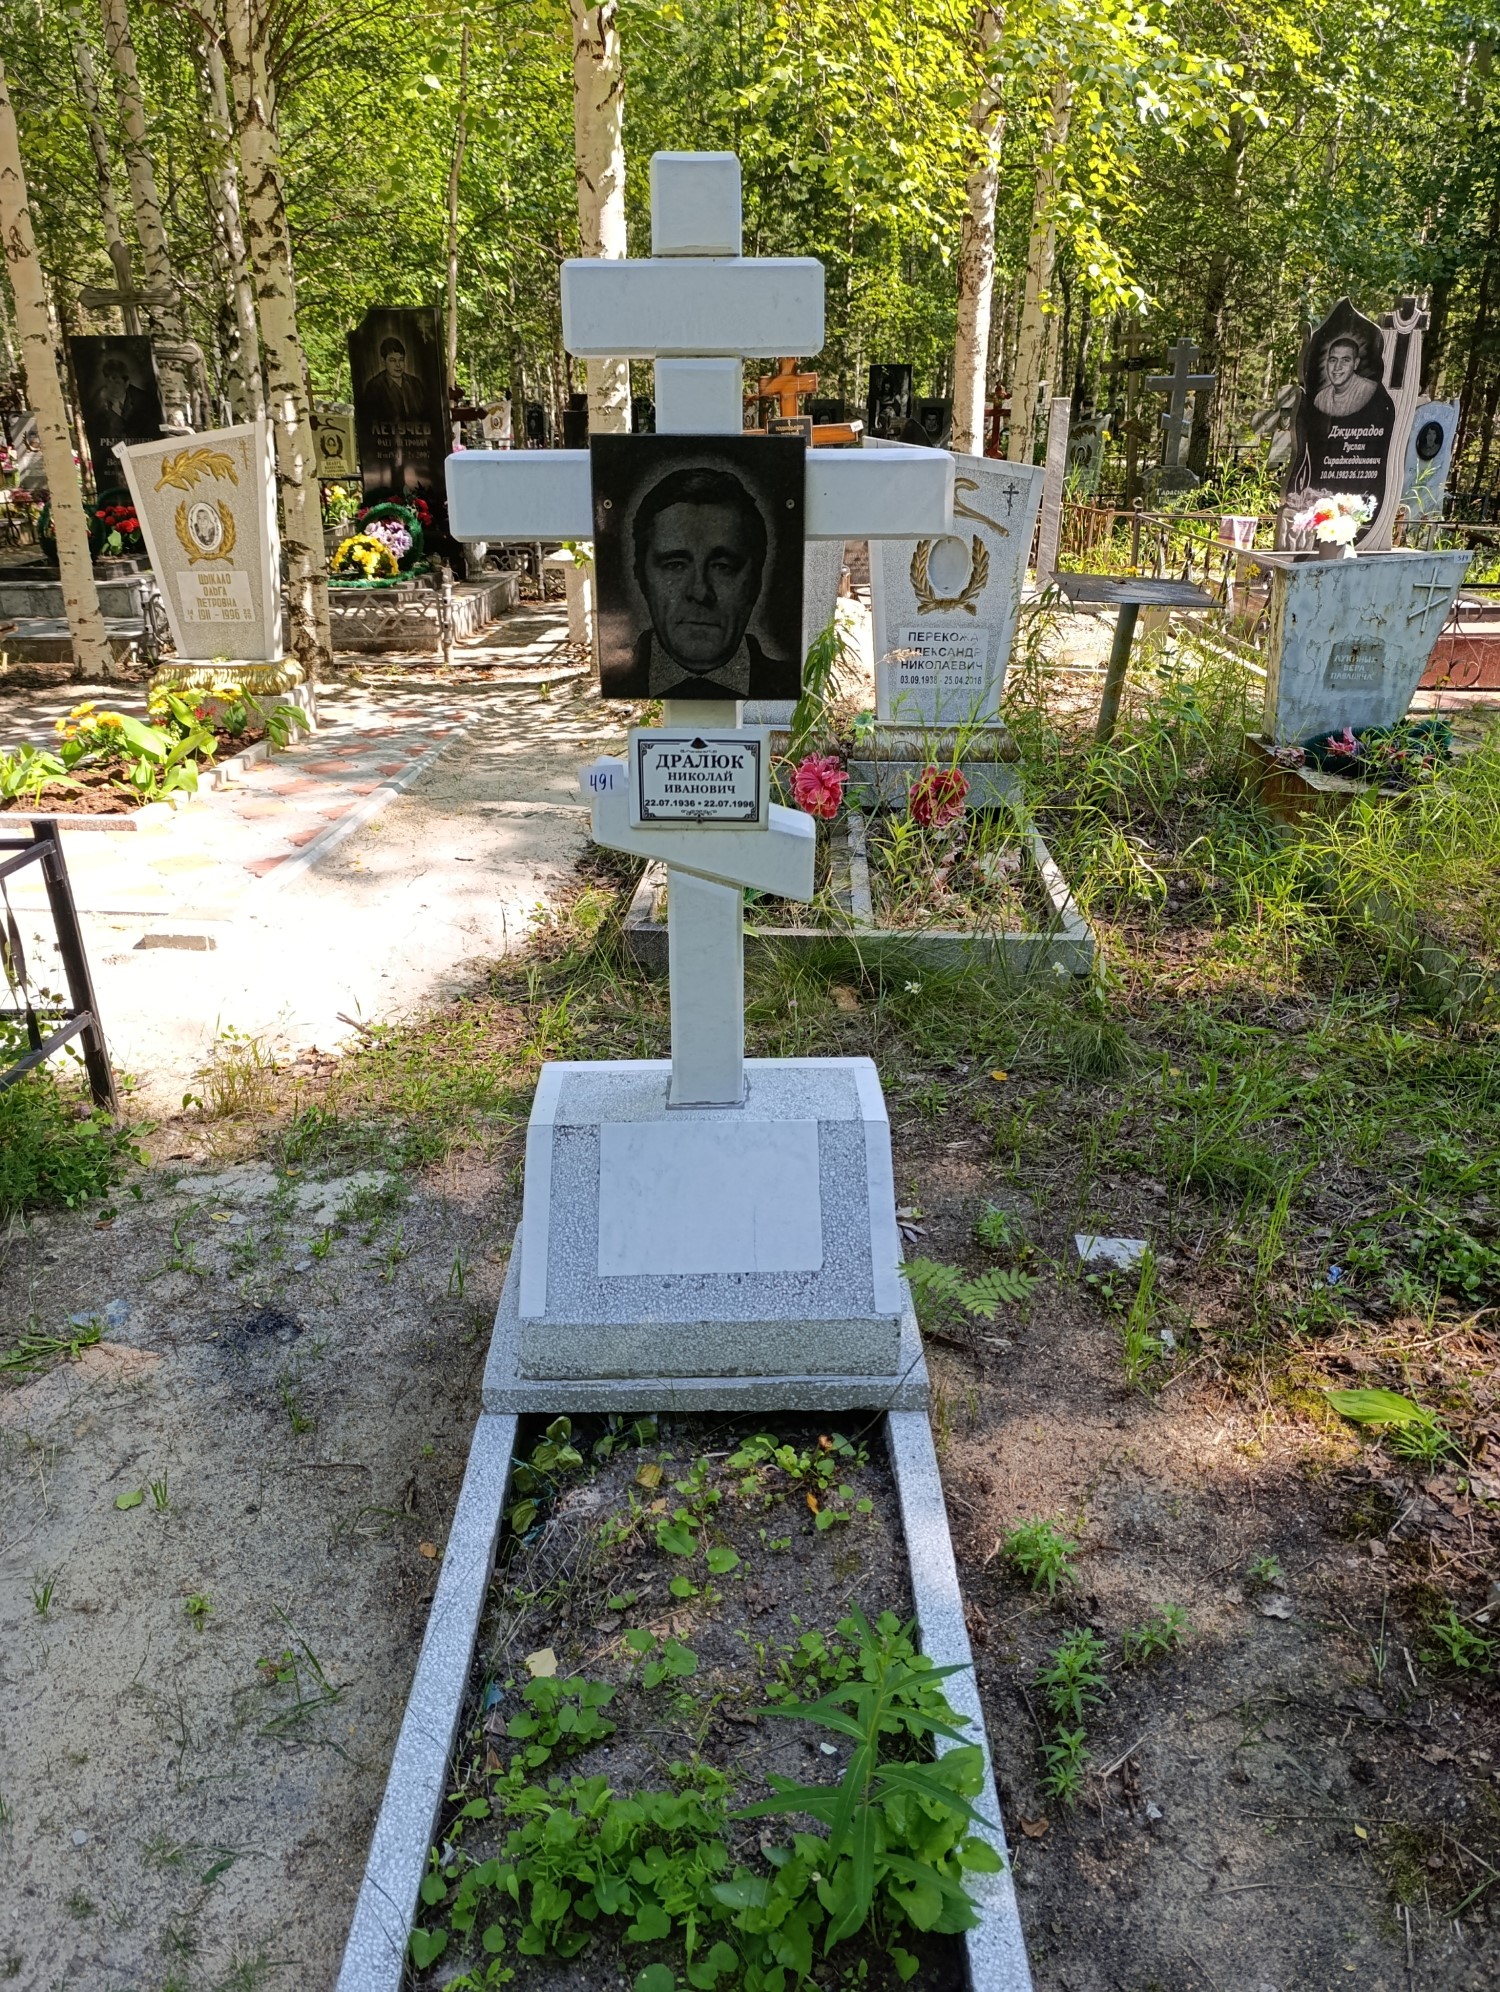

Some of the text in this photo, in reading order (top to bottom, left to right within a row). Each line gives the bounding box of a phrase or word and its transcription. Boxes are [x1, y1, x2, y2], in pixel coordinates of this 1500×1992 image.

[1328, 424, 1384, 440] Джумрадов
[1343, 442, 1366, 453] Руслан
[203, 586, 228, 597] ОЛЬГА
[197, 597, 237, 608] ПЕТРОВНА
[221, 608, 240, 620] 1996
[908, 632, 979, 642] ПЕРЕКОЖА
[901, 660, 983, 670] НИКОЛАЕВИЧ
[656, 754, 744, 770] ДРАЛЮК
[667, 771, 733, 782] НИКОЛАЙ
[589, 773, 614, 793] 491
[664, 784, 736, 794] ИВАНОВИЧ
[645, 799, 754, 808] 22.07.1936 22.07.1996
